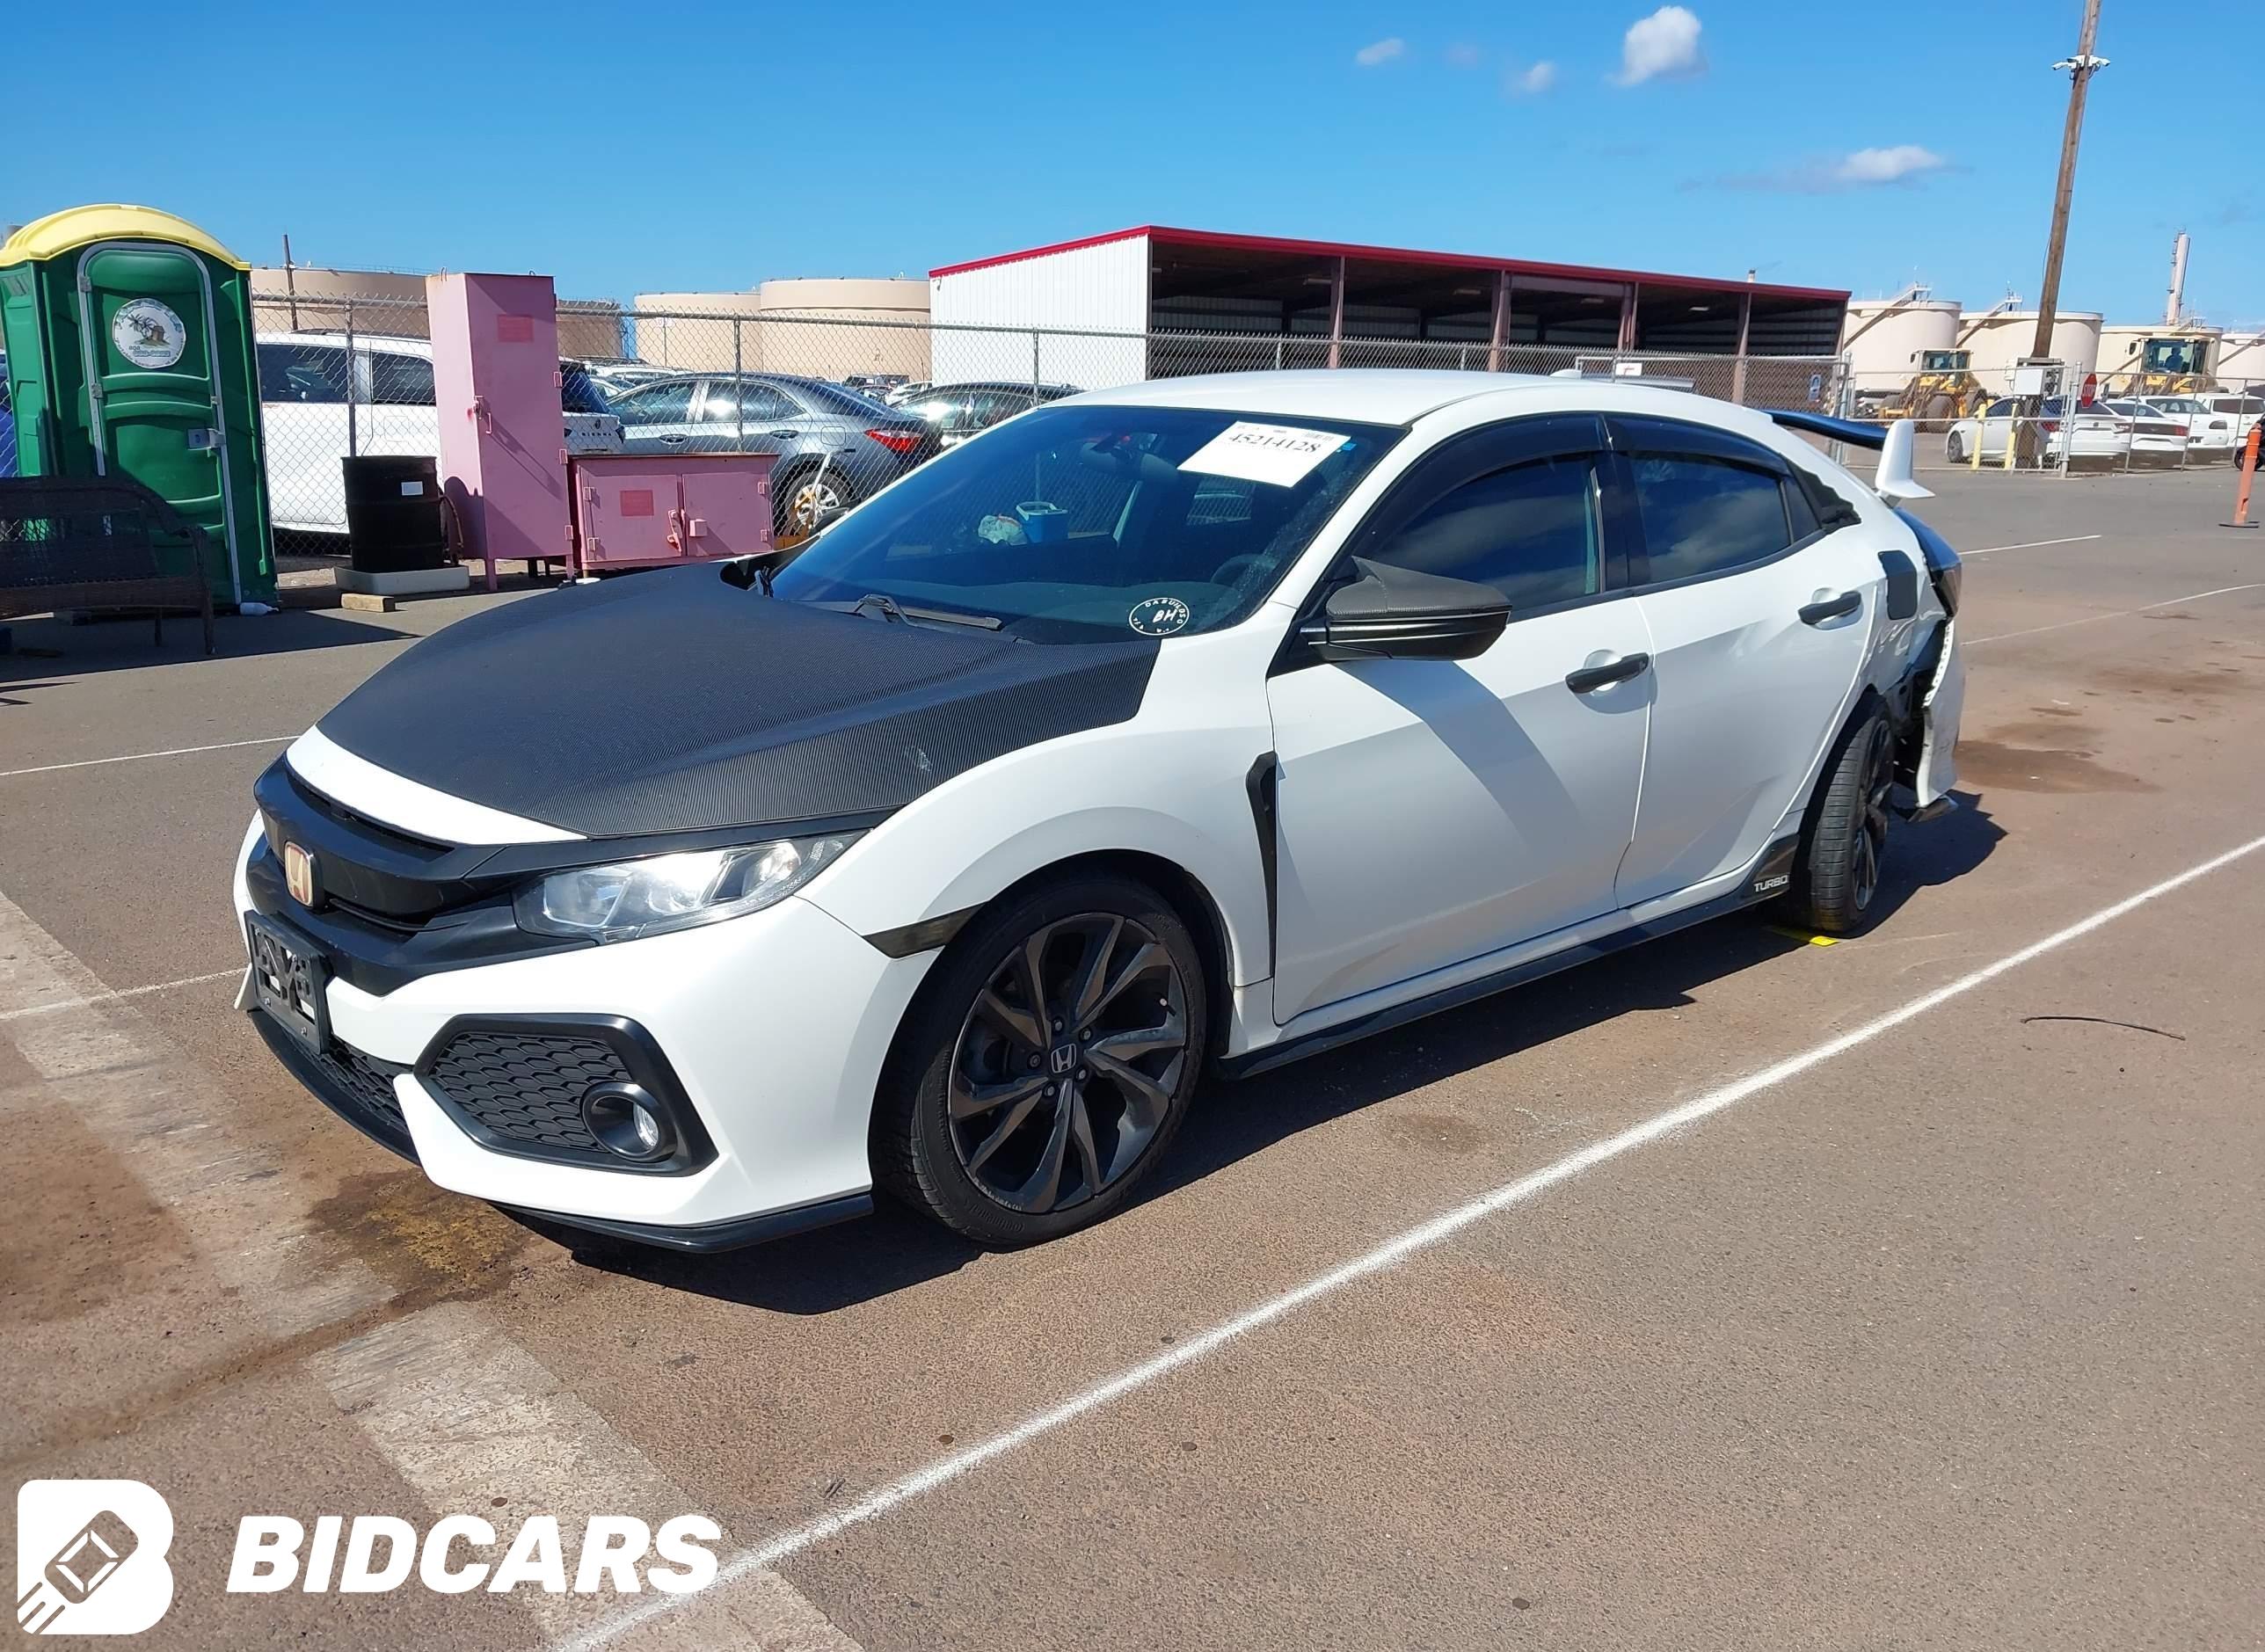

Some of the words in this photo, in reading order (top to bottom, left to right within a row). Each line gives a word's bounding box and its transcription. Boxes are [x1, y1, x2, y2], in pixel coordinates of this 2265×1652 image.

[2081, 383, 2097, 397] STOP
[1227, 433, 1321, 454] 45214128
[1152, 608, 1178, 623] BH
[1753, 874, 1790, 892] TURBO
